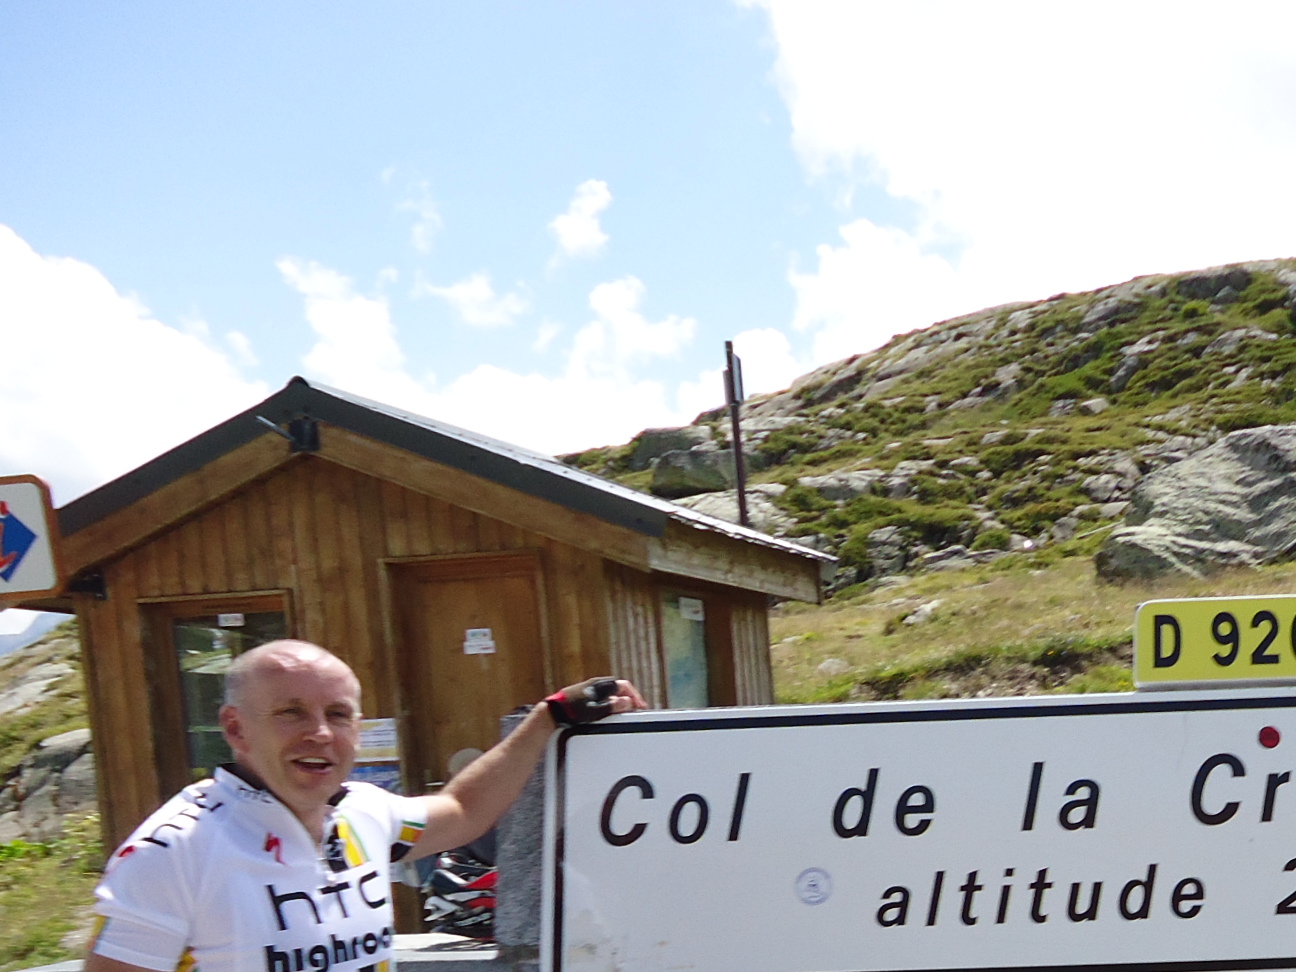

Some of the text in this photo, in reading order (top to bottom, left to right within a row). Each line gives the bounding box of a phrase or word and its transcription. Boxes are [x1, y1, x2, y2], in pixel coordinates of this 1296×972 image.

[1153, 614, 1182, 669] D
[600, 772, 751, 847] Col
[832, 767, 935, 839] de
[1021, 761, 1100, 831] la
[876, 863, 1205, 928] altitude
